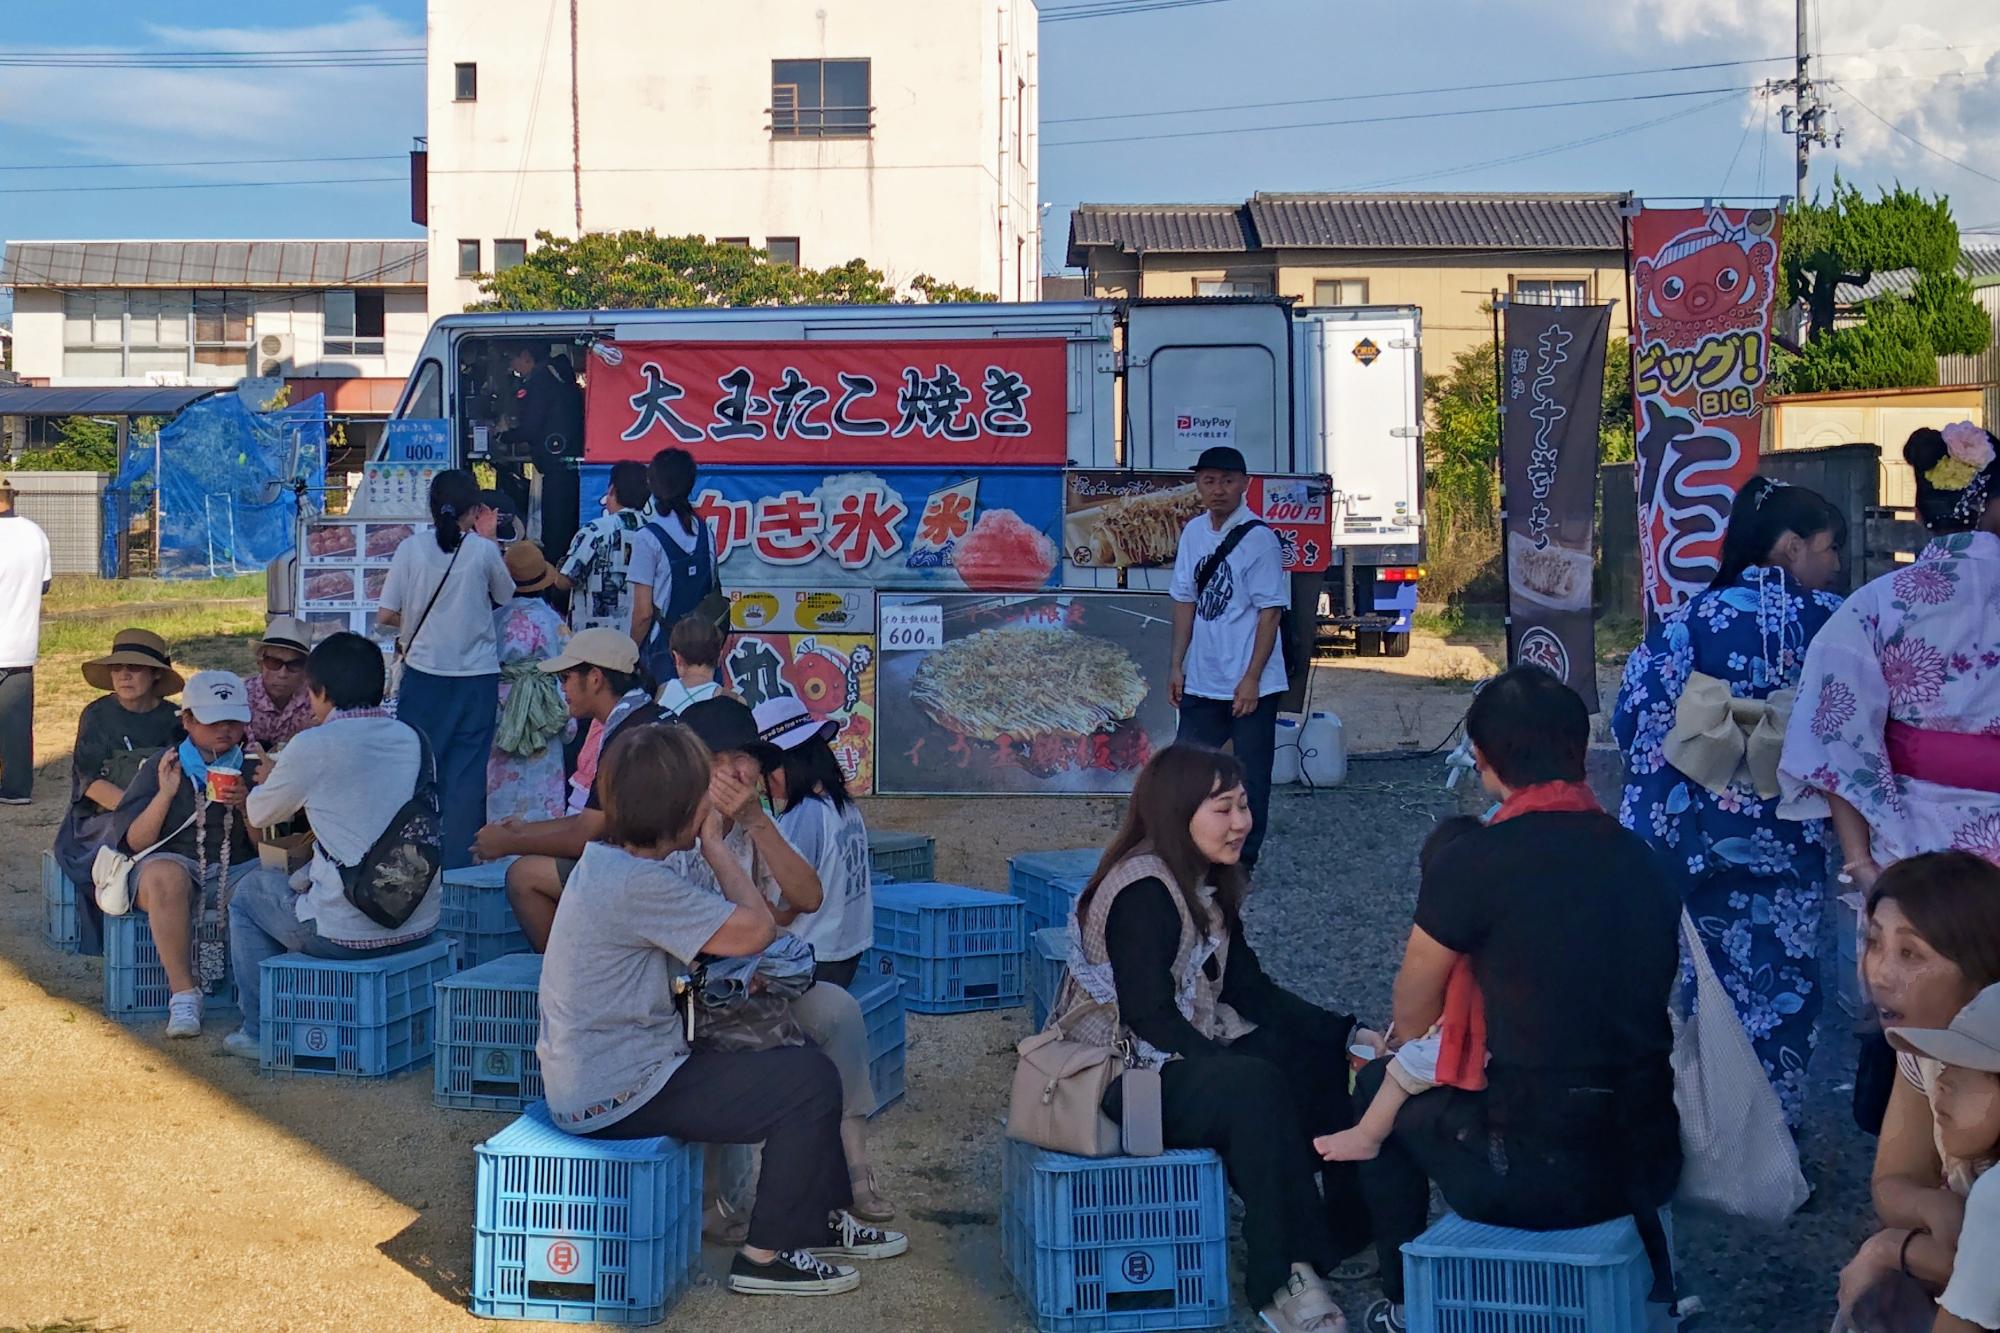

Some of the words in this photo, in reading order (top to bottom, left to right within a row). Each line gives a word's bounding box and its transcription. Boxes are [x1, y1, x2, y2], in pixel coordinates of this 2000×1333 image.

[622, 362, 1032, 442] 大玉たこ焼き
[1701, 387, 1750, 417] BIG
[1193, 417, 1231, 428] PayPay
[918, 492, 974, 544] 氷
[1266, 503, 1322, 520] 400円
[695, 491, 906, 567] かき氷
[889, 627, 935, 645] 600円
